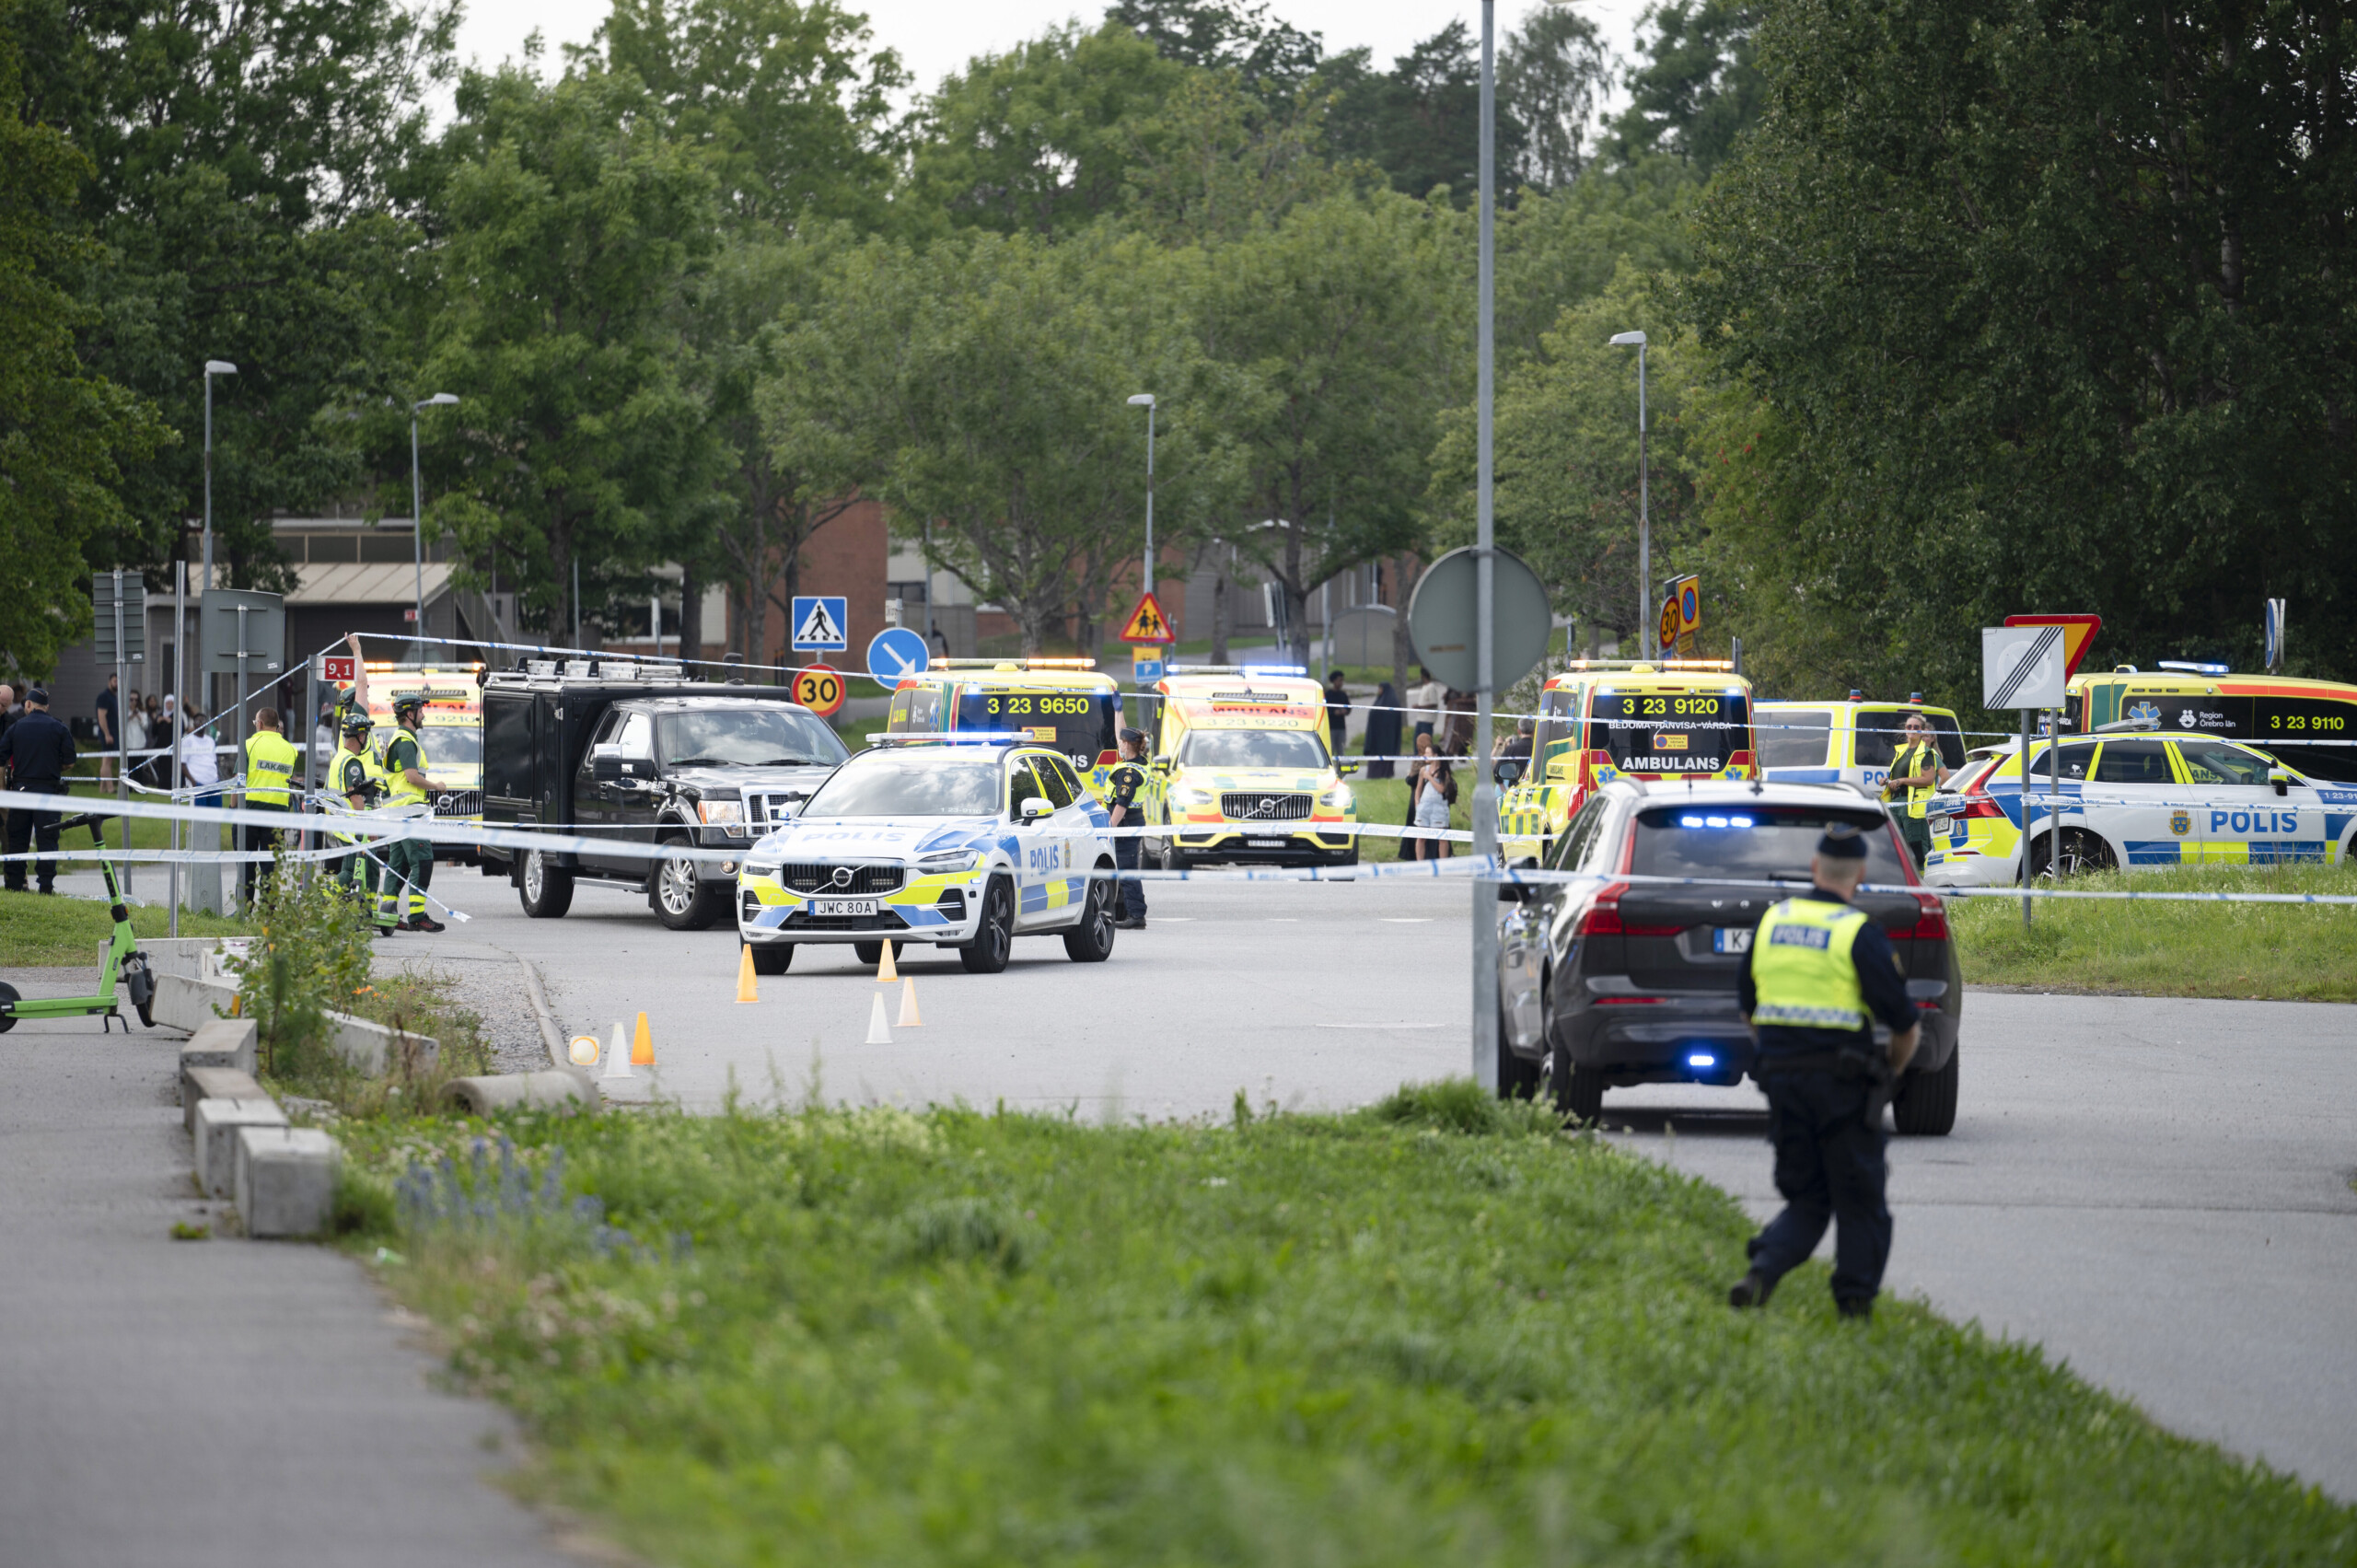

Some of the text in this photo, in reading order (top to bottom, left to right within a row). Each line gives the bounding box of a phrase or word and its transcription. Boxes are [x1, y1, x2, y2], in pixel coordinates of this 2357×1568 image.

[1663, 610, 1677, 635] 30
[1144, 664, 1152, 675] P
[803, 678, 837, 703] 30
[987, 698, 1089, 714] 3 23 9650
[1623, 699, 1718, 714] 3 23 9120
[2200, 712, 2223, 721] Region
[2200, 719, 2236, 727] Örebro län
[2270, 715, 2344, 730] 3 23 9110
[1622, 757, 1720, 770] AMBULANS
[2211, 811, 2298, 833] POLIS
[803, 831, 906, 842] POLIS
[1030, 845, 1059, 877] POLIS
[819, 901, 873, 914] JWC 80A
[1773, 925, 1826, 947] POLIS
